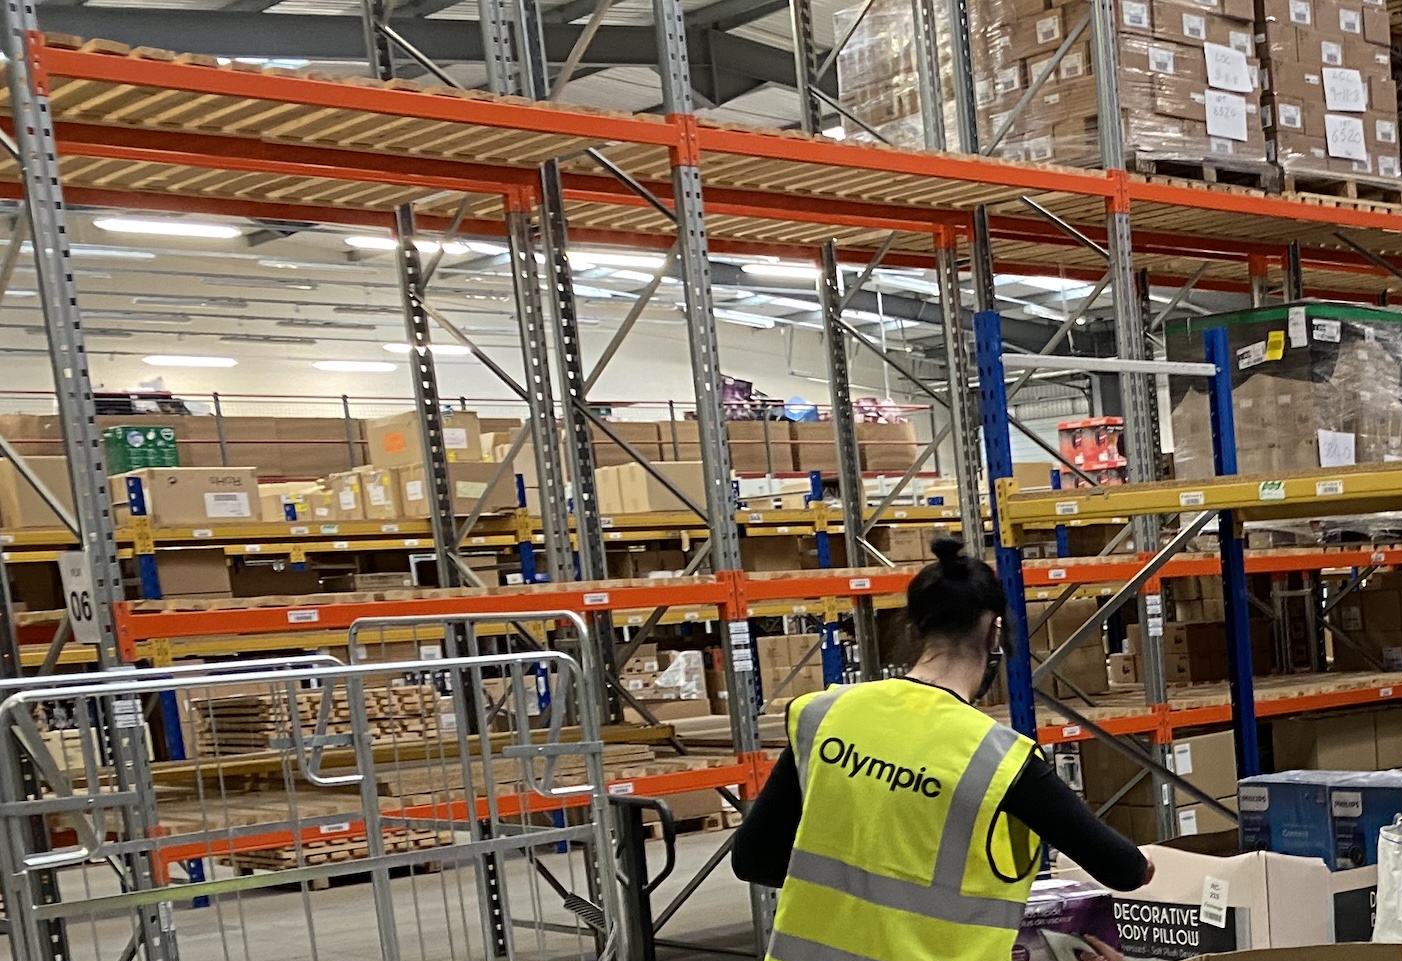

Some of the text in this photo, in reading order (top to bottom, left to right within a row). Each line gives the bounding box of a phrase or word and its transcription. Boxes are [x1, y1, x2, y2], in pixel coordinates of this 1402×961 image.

[1331, 129, 1361, 144] 6520
[70, 591, 92, 621] 06
[819, 737, 941, 798] Olympic
[1114, 903, 1198, 927] DECORATIVE
[1153, 927, 1199, 946] PILLOW
